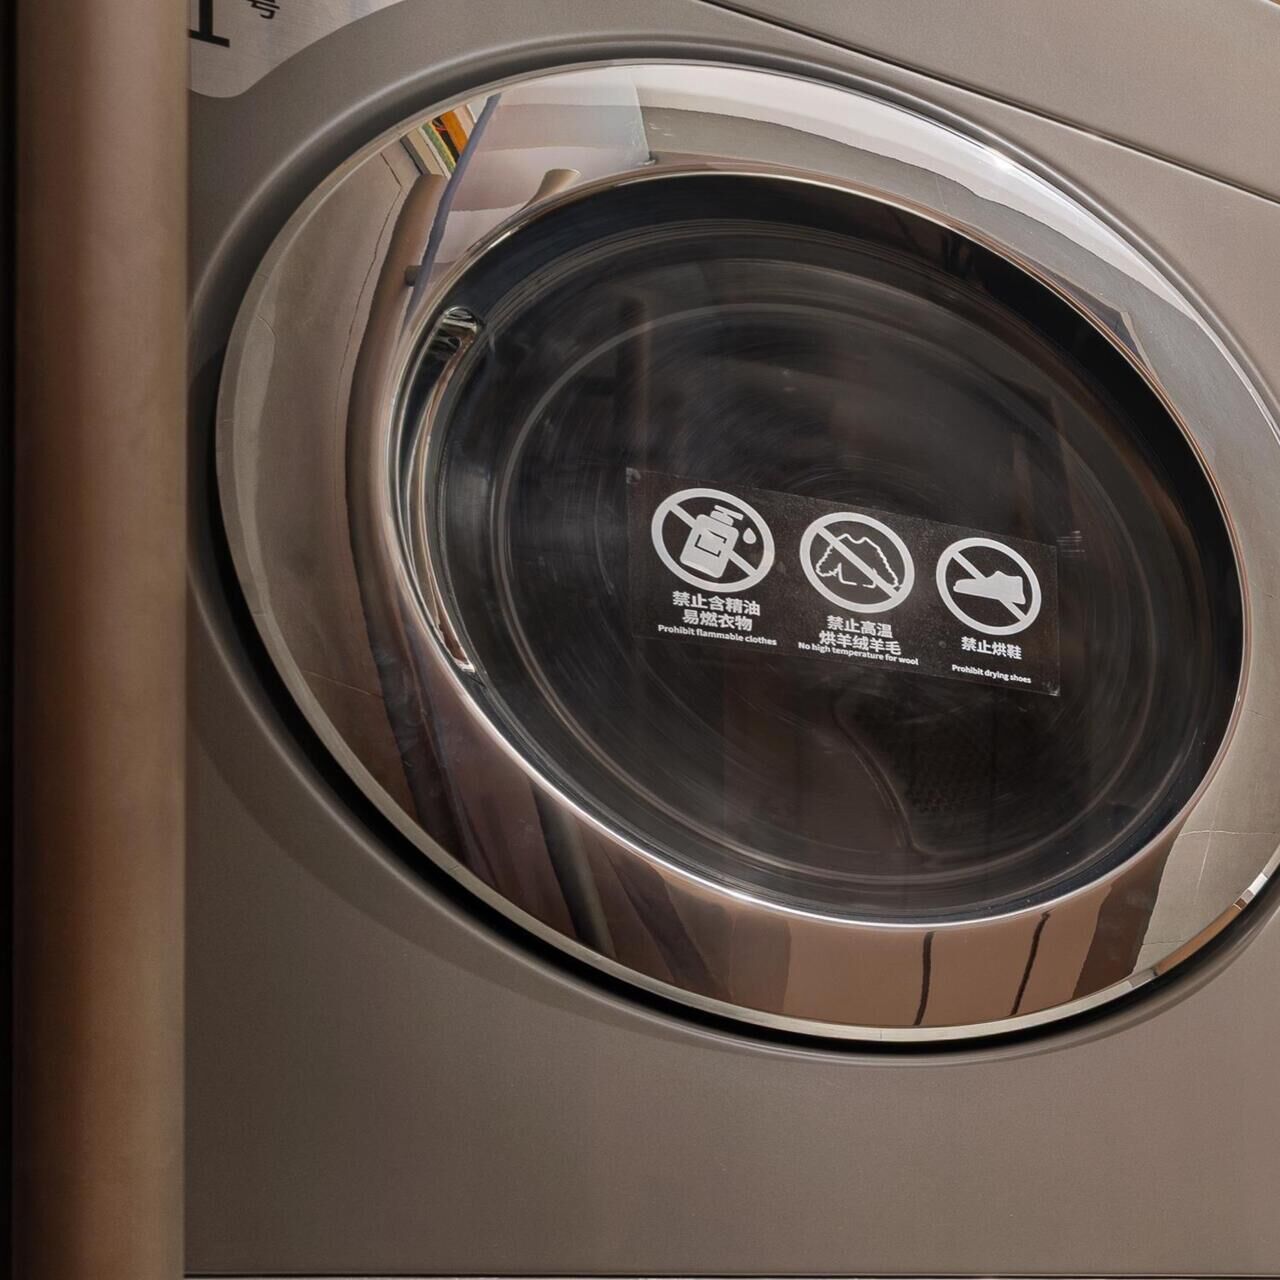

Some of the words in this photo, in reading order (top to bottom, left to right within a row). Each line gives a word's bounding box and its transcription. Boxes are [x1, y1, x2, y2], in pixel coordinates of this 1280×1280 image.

[673, 591, 761, 617] 禁止含精油
[682, 609, 752, 631] 易燃衣物
[827, 615, 893, 638] 禁止高温
[658, 624, 695, 636] Prohibit
[696, 628, 743, 643] flammable
[745, 635, 777, 645] clothes
[819, 629, 900, 656] 烘羊绒羊毛
[798, 641, 810, 651] No
[812, 644, 831, 656] high
[833, 647, 883, 661] temperature
[885, 653, 897, 662] for
[898, 655, 918, 666] wool
[961, 637, 1021, 660] 禁止烘鞋
[952, 663, 984, 675] Prohibit
[985, 669, 1008, 681] drying
[1009, 674, 1031, 684] shoes
